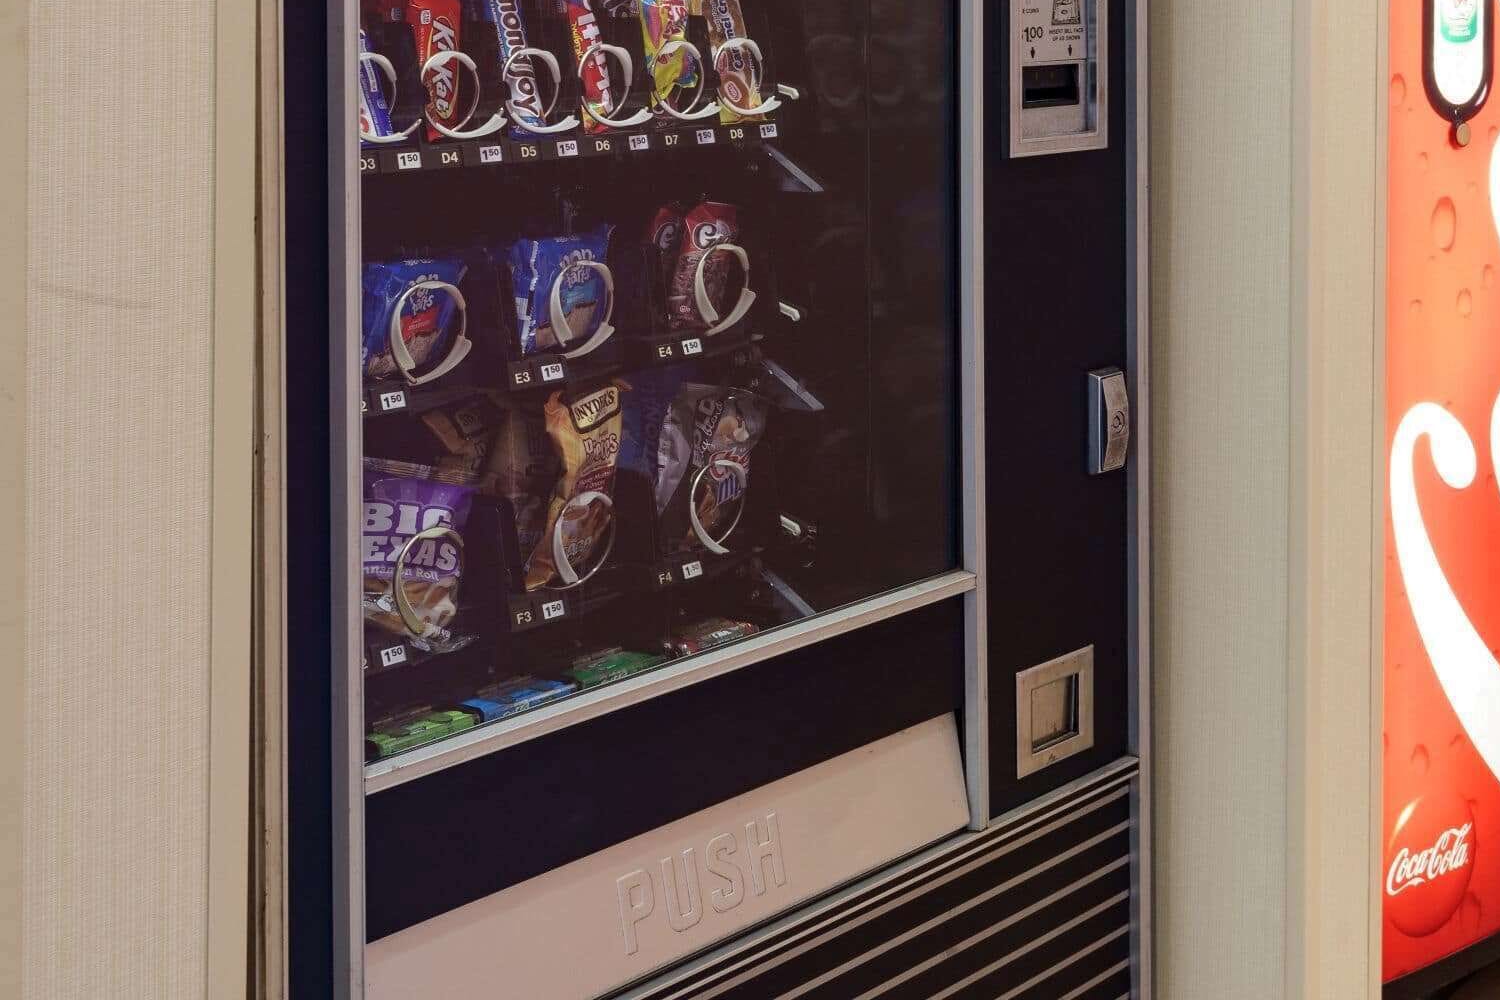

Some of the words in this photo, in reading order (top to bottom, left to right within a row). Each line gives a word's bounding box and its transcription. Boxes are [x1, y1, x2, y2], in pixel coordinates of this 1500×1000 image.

[730, 128, 744, 139] D8
[595, 140, 610, 152] D6
[665, 135, 678, 146] D7
[441, 152, 459, 164] D4
[520, 146, 537, 158] D5
[658, 346, 673, 358] E4
[514, 372, 531, 384] E3
[362, 501, 453, 535] BIG
[362, 534, 459, 572] EXAS
[658, 571, 673, 585] F4
[516, 611, 532, 625] F3
[1386, 821, 1473, 896] Coca-Cola
[614, 809, 788, 957] PUSH
